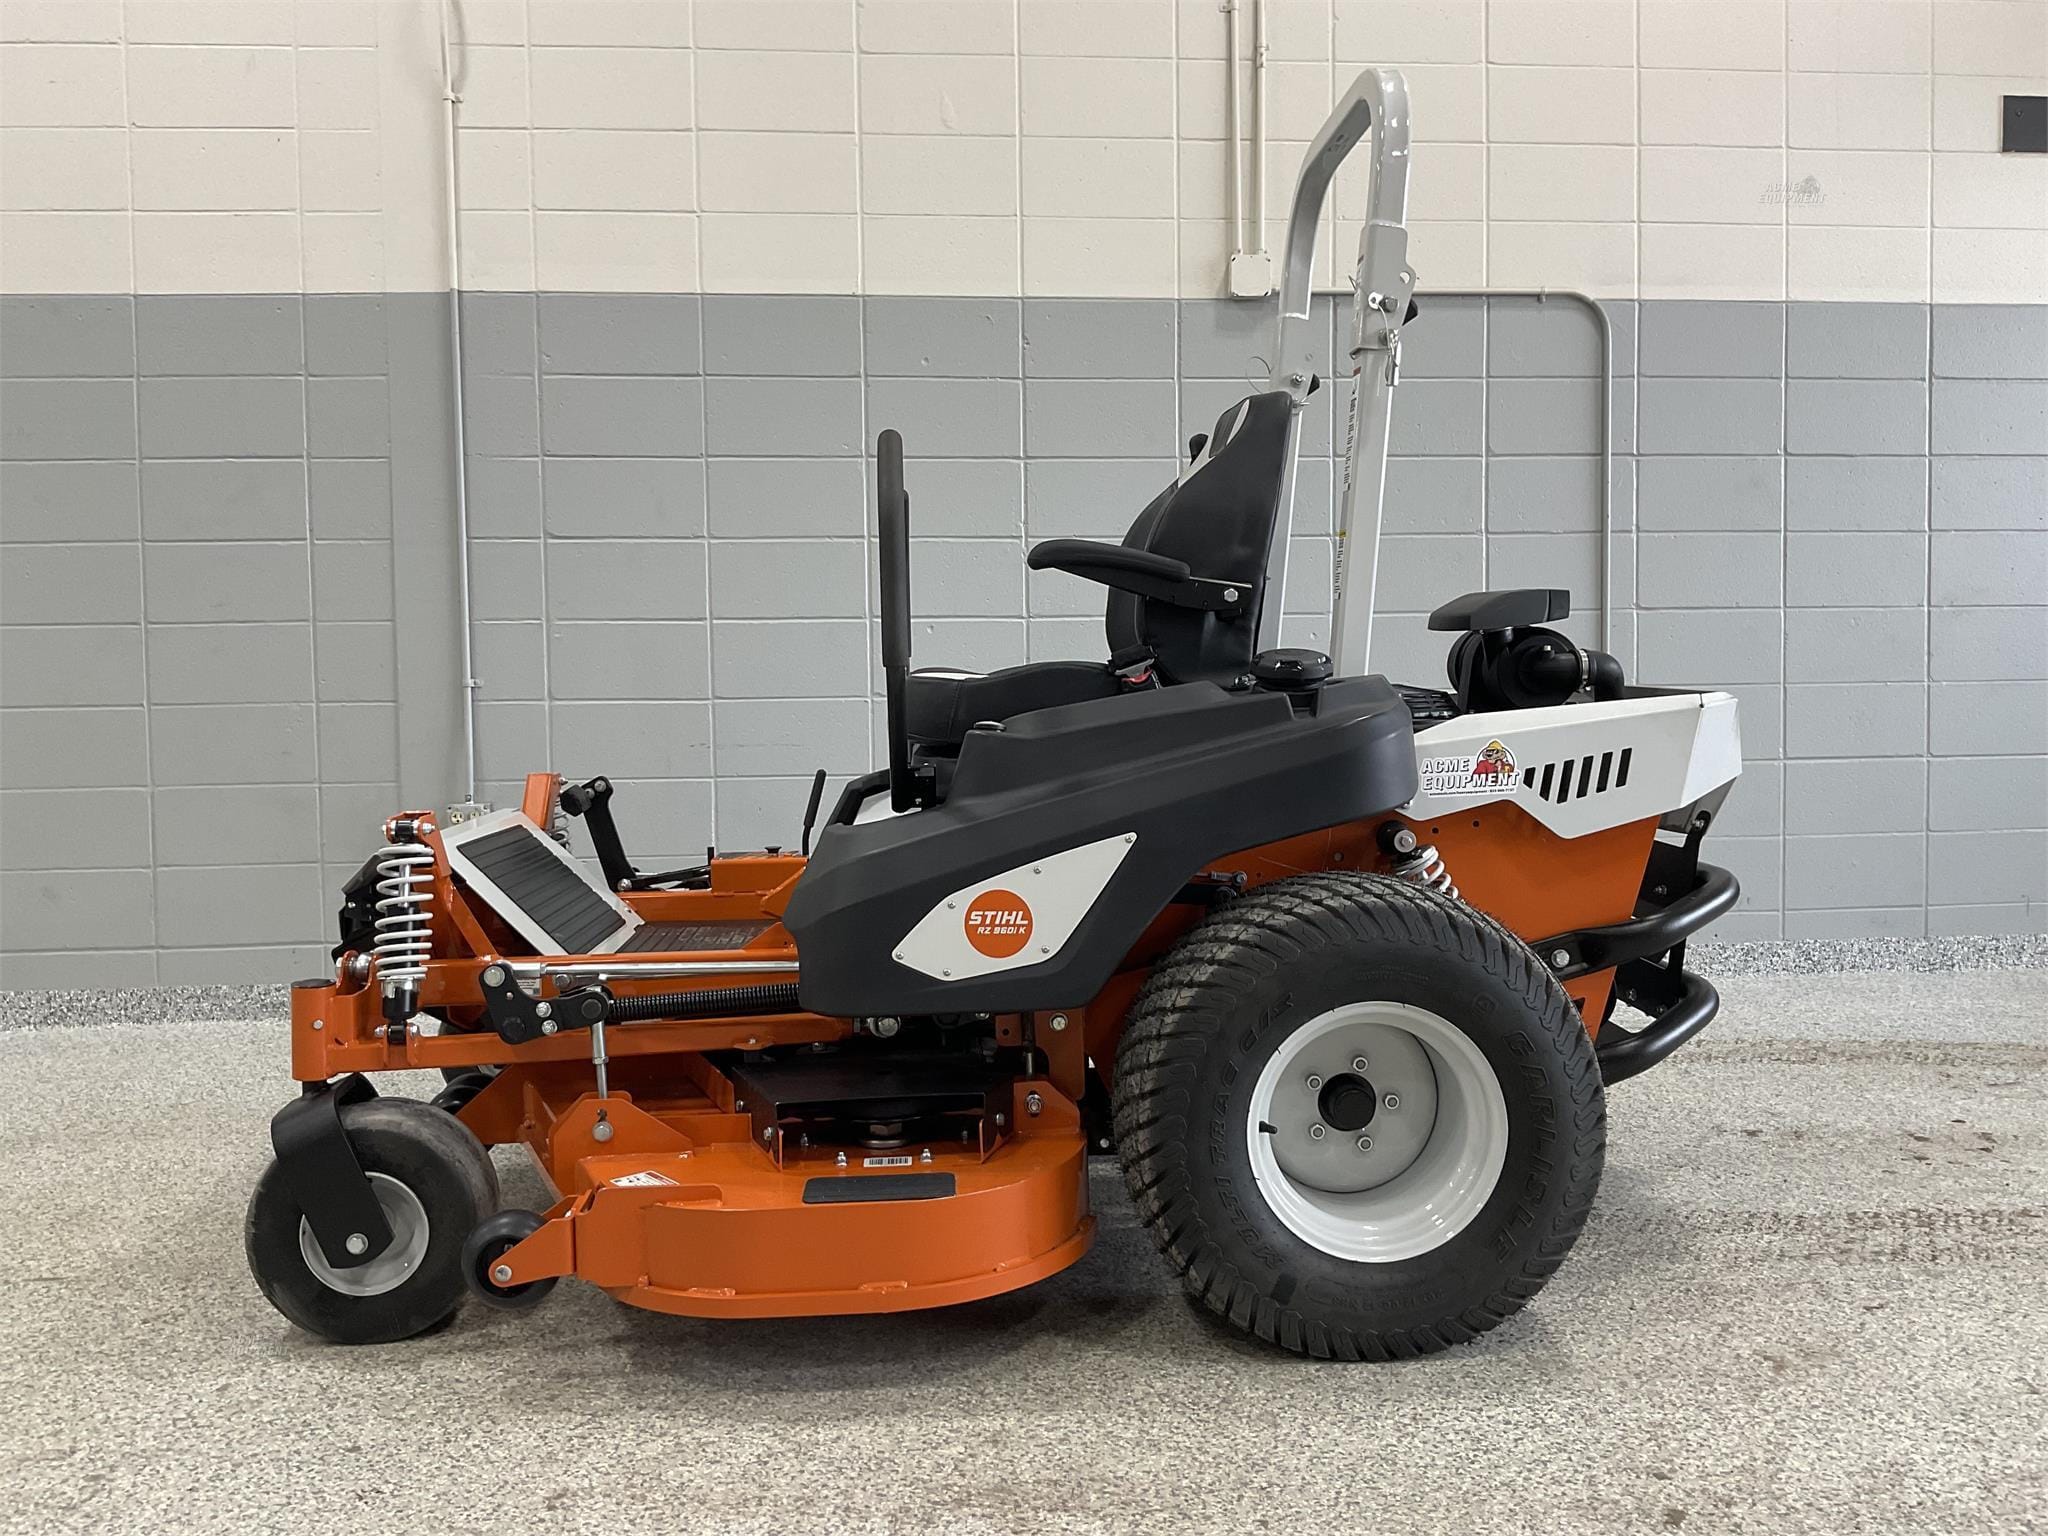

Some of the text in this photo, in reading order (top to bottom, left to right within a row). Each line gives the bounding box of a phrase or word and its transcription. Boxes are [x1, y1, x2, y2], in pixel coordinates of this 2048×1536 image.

[1422, 758, 1470, 774] ACME
[1423, 773, 1519, 790] EQUIPMENT
[968, 911, 1029, 925] STIHL
[977, 926, 992, 934] RZ
[1018, 926, 1027, 934] K
[1210, 1061, 1239, 1164] TRAC
[1490, 1030, 1556, 1262] CARLISLE
